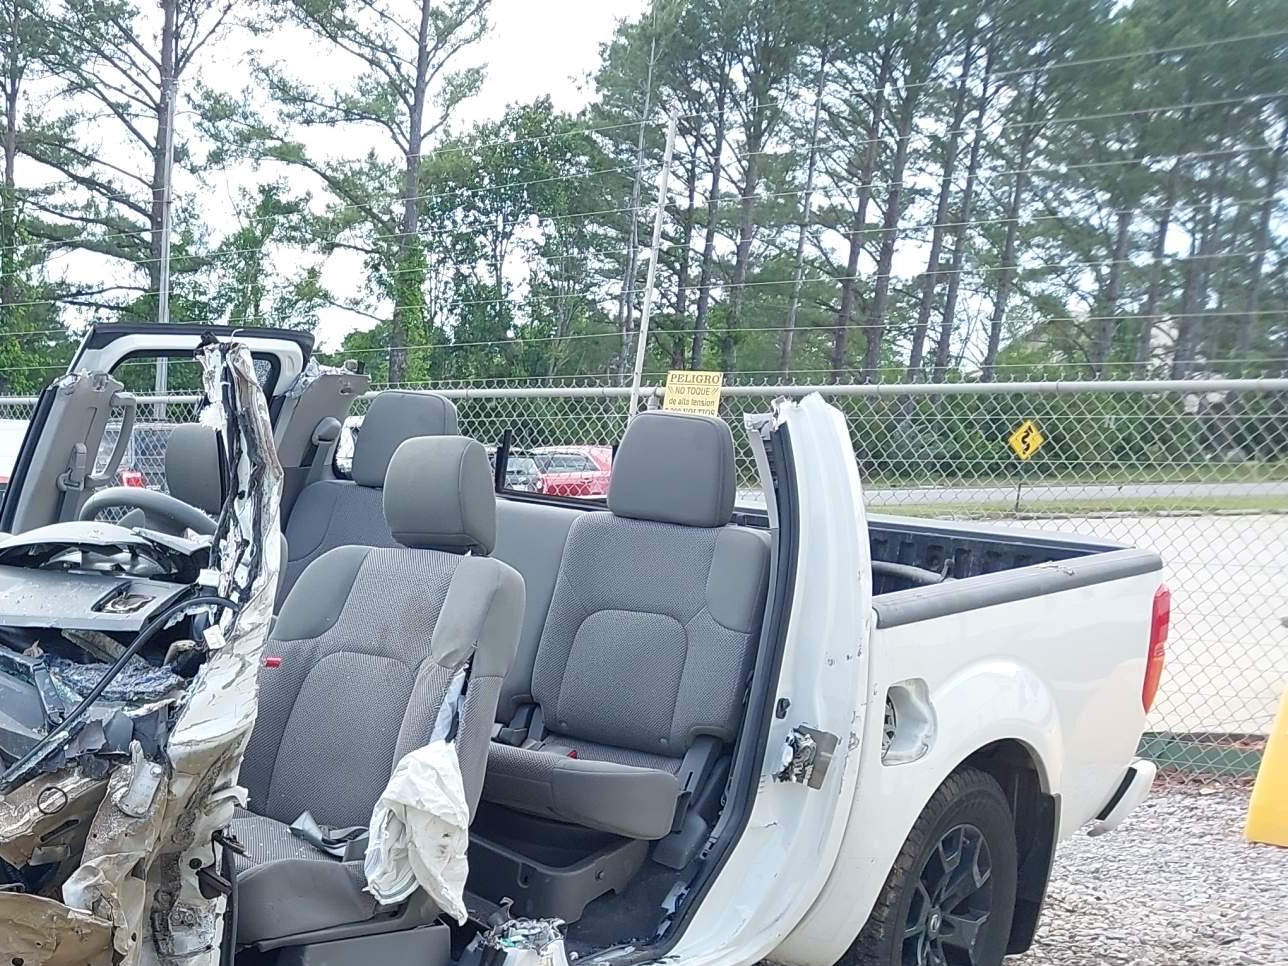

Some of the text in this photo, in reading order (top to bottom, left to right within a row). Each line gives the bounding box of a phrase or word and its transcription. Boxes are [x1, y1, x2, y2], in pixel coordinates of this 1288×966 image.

[671, 374, 720, 384] PELIGRO
[675, 386, 710, 395] NO TOQUE
